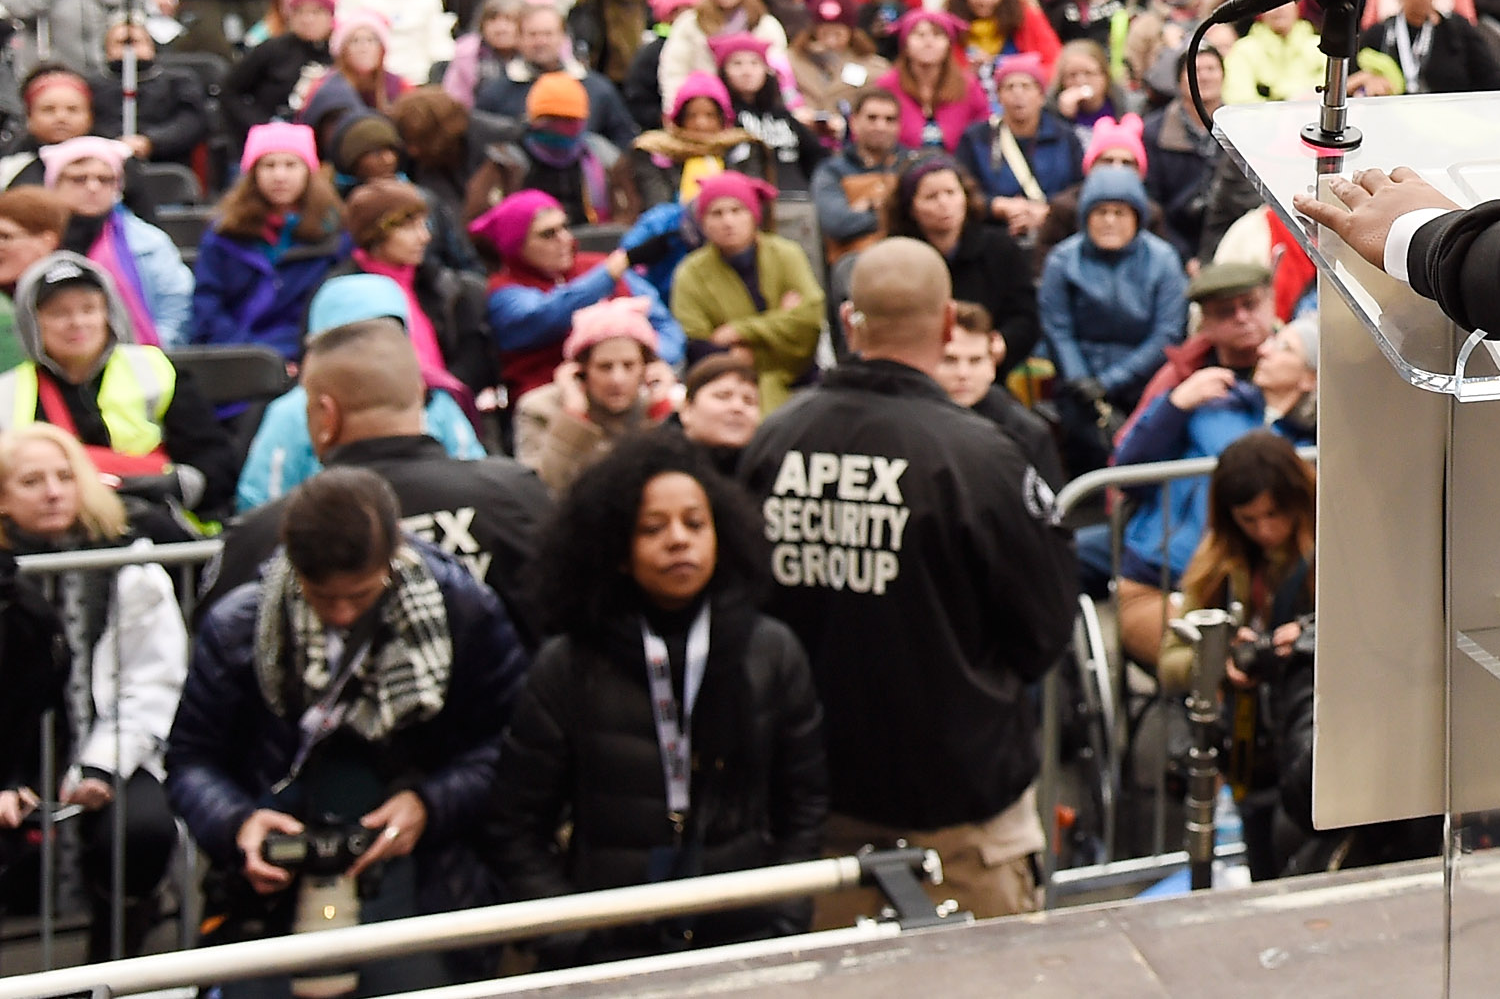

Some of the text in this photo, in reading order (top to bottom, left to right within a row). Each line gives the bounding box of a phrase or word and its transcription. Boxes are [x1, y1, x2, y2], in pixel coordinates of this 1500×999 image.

[773, 450, 909, 505] APEX
[762, 496, 910, 551] SECURITY
[771, 543, 900, 595] GROUP
